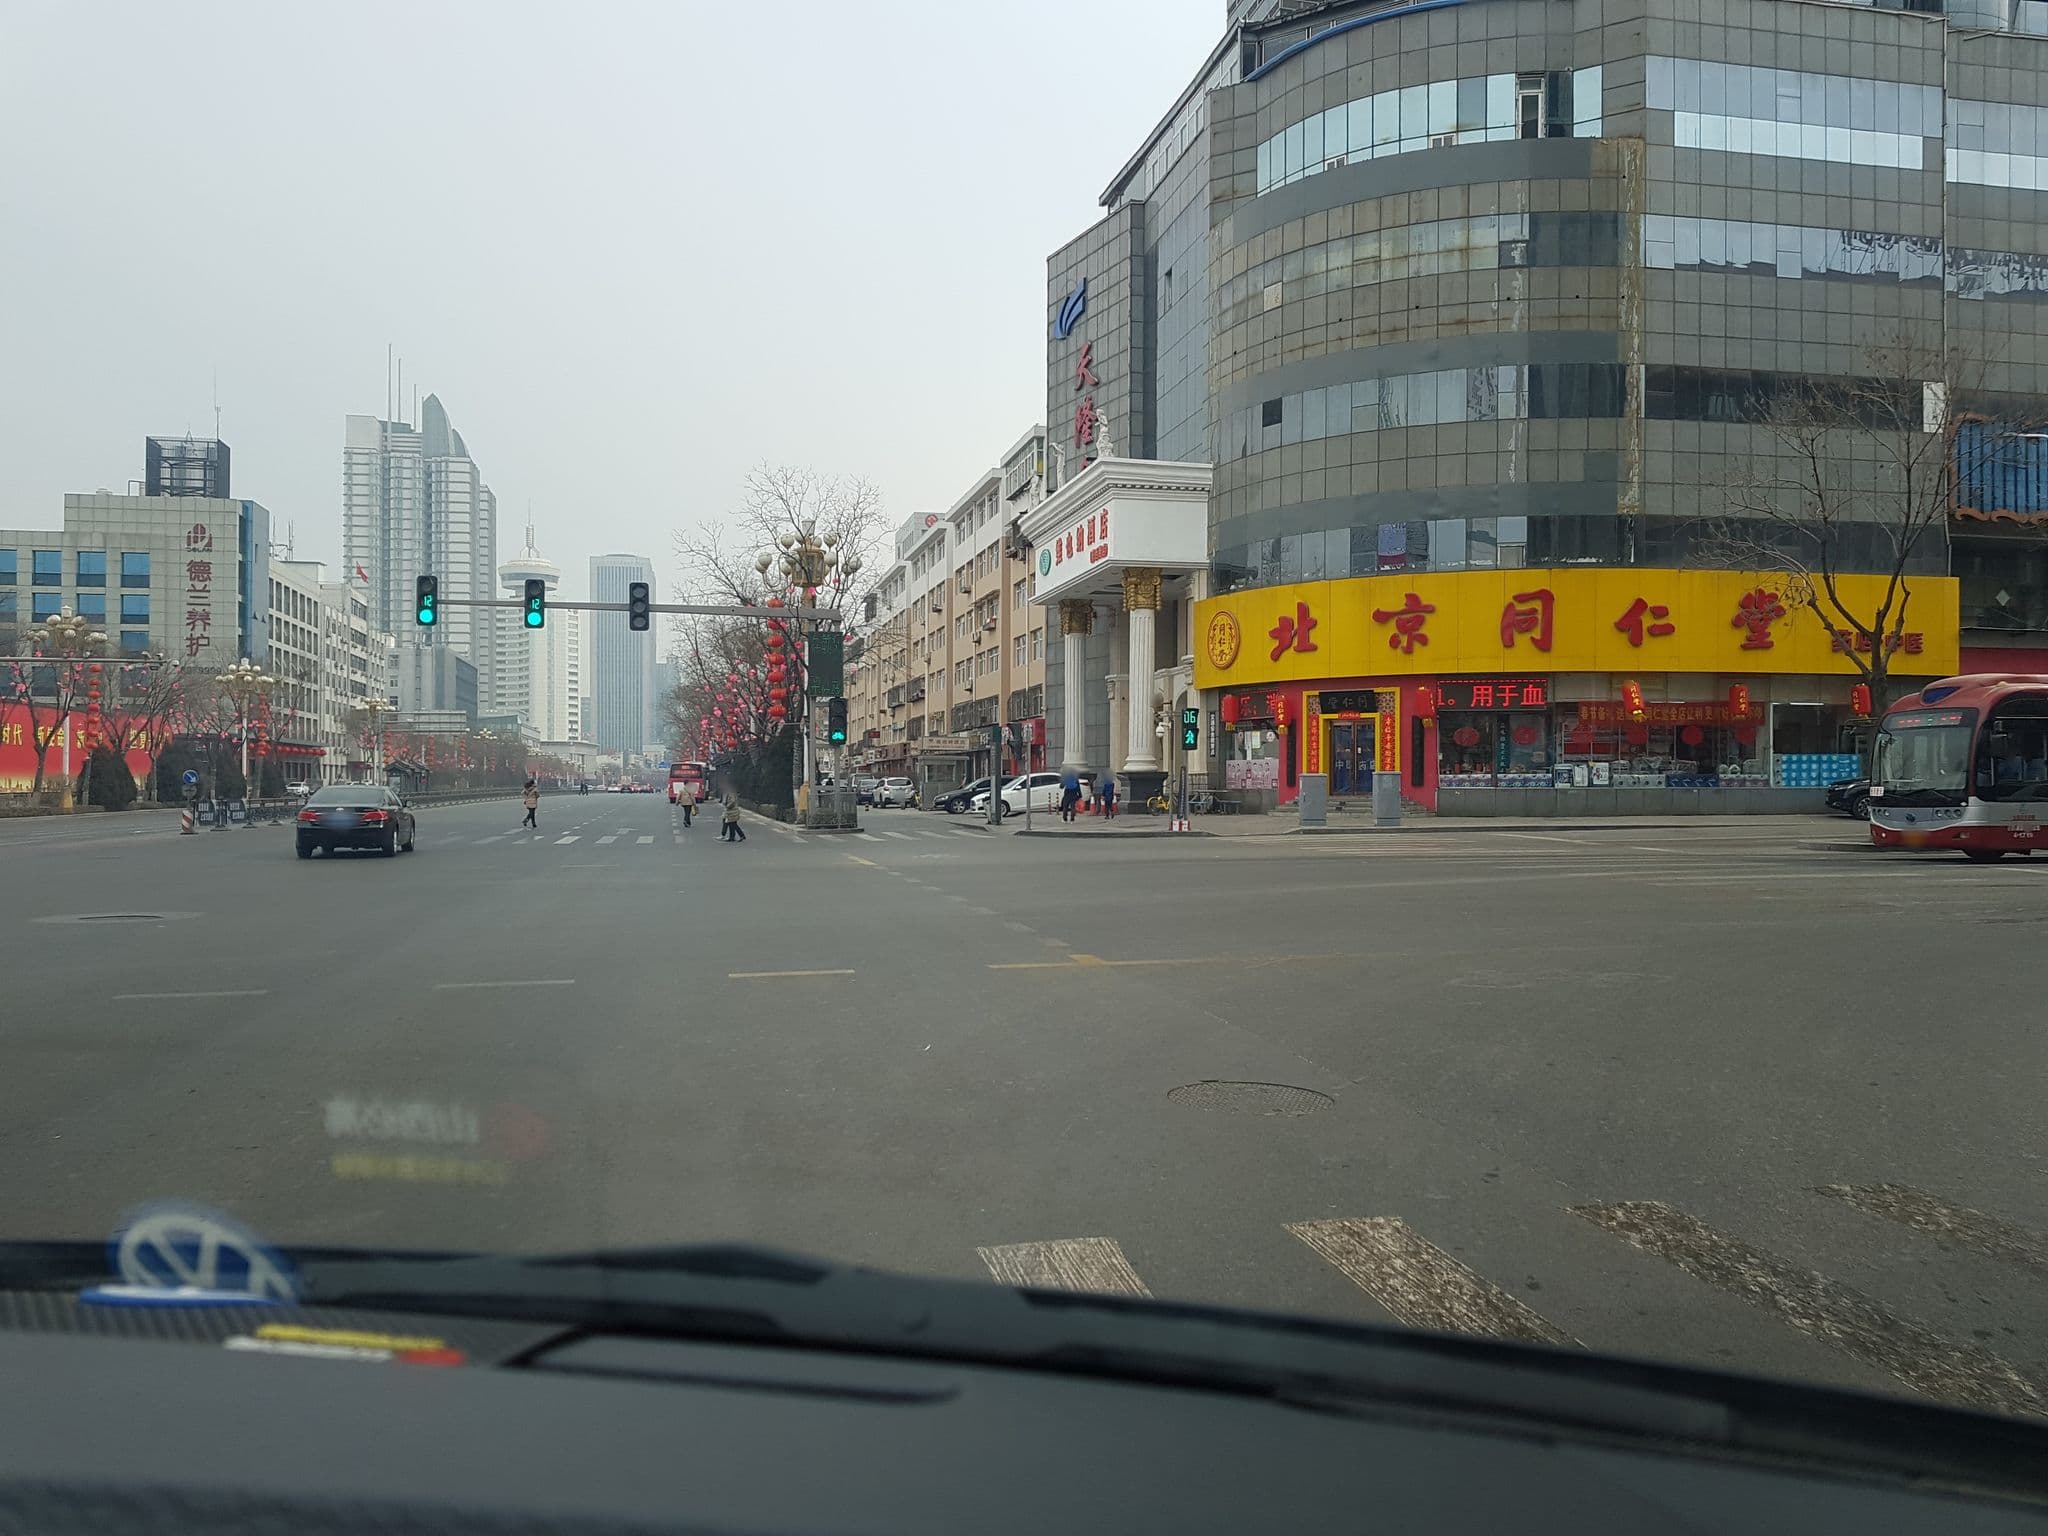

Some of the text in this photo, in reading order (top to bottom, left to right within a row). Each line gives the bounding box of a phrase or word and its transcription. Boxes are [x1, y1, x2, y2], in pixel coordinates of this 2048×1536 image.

[423, 595, 433, 607] 12
[532, 599, 540, 610] 12
[186, 560, 213, 657] 德兰养护
[1268, 588, 1787, 662] 北京同仁堂
[1183, 711, 1196, 724] 06
